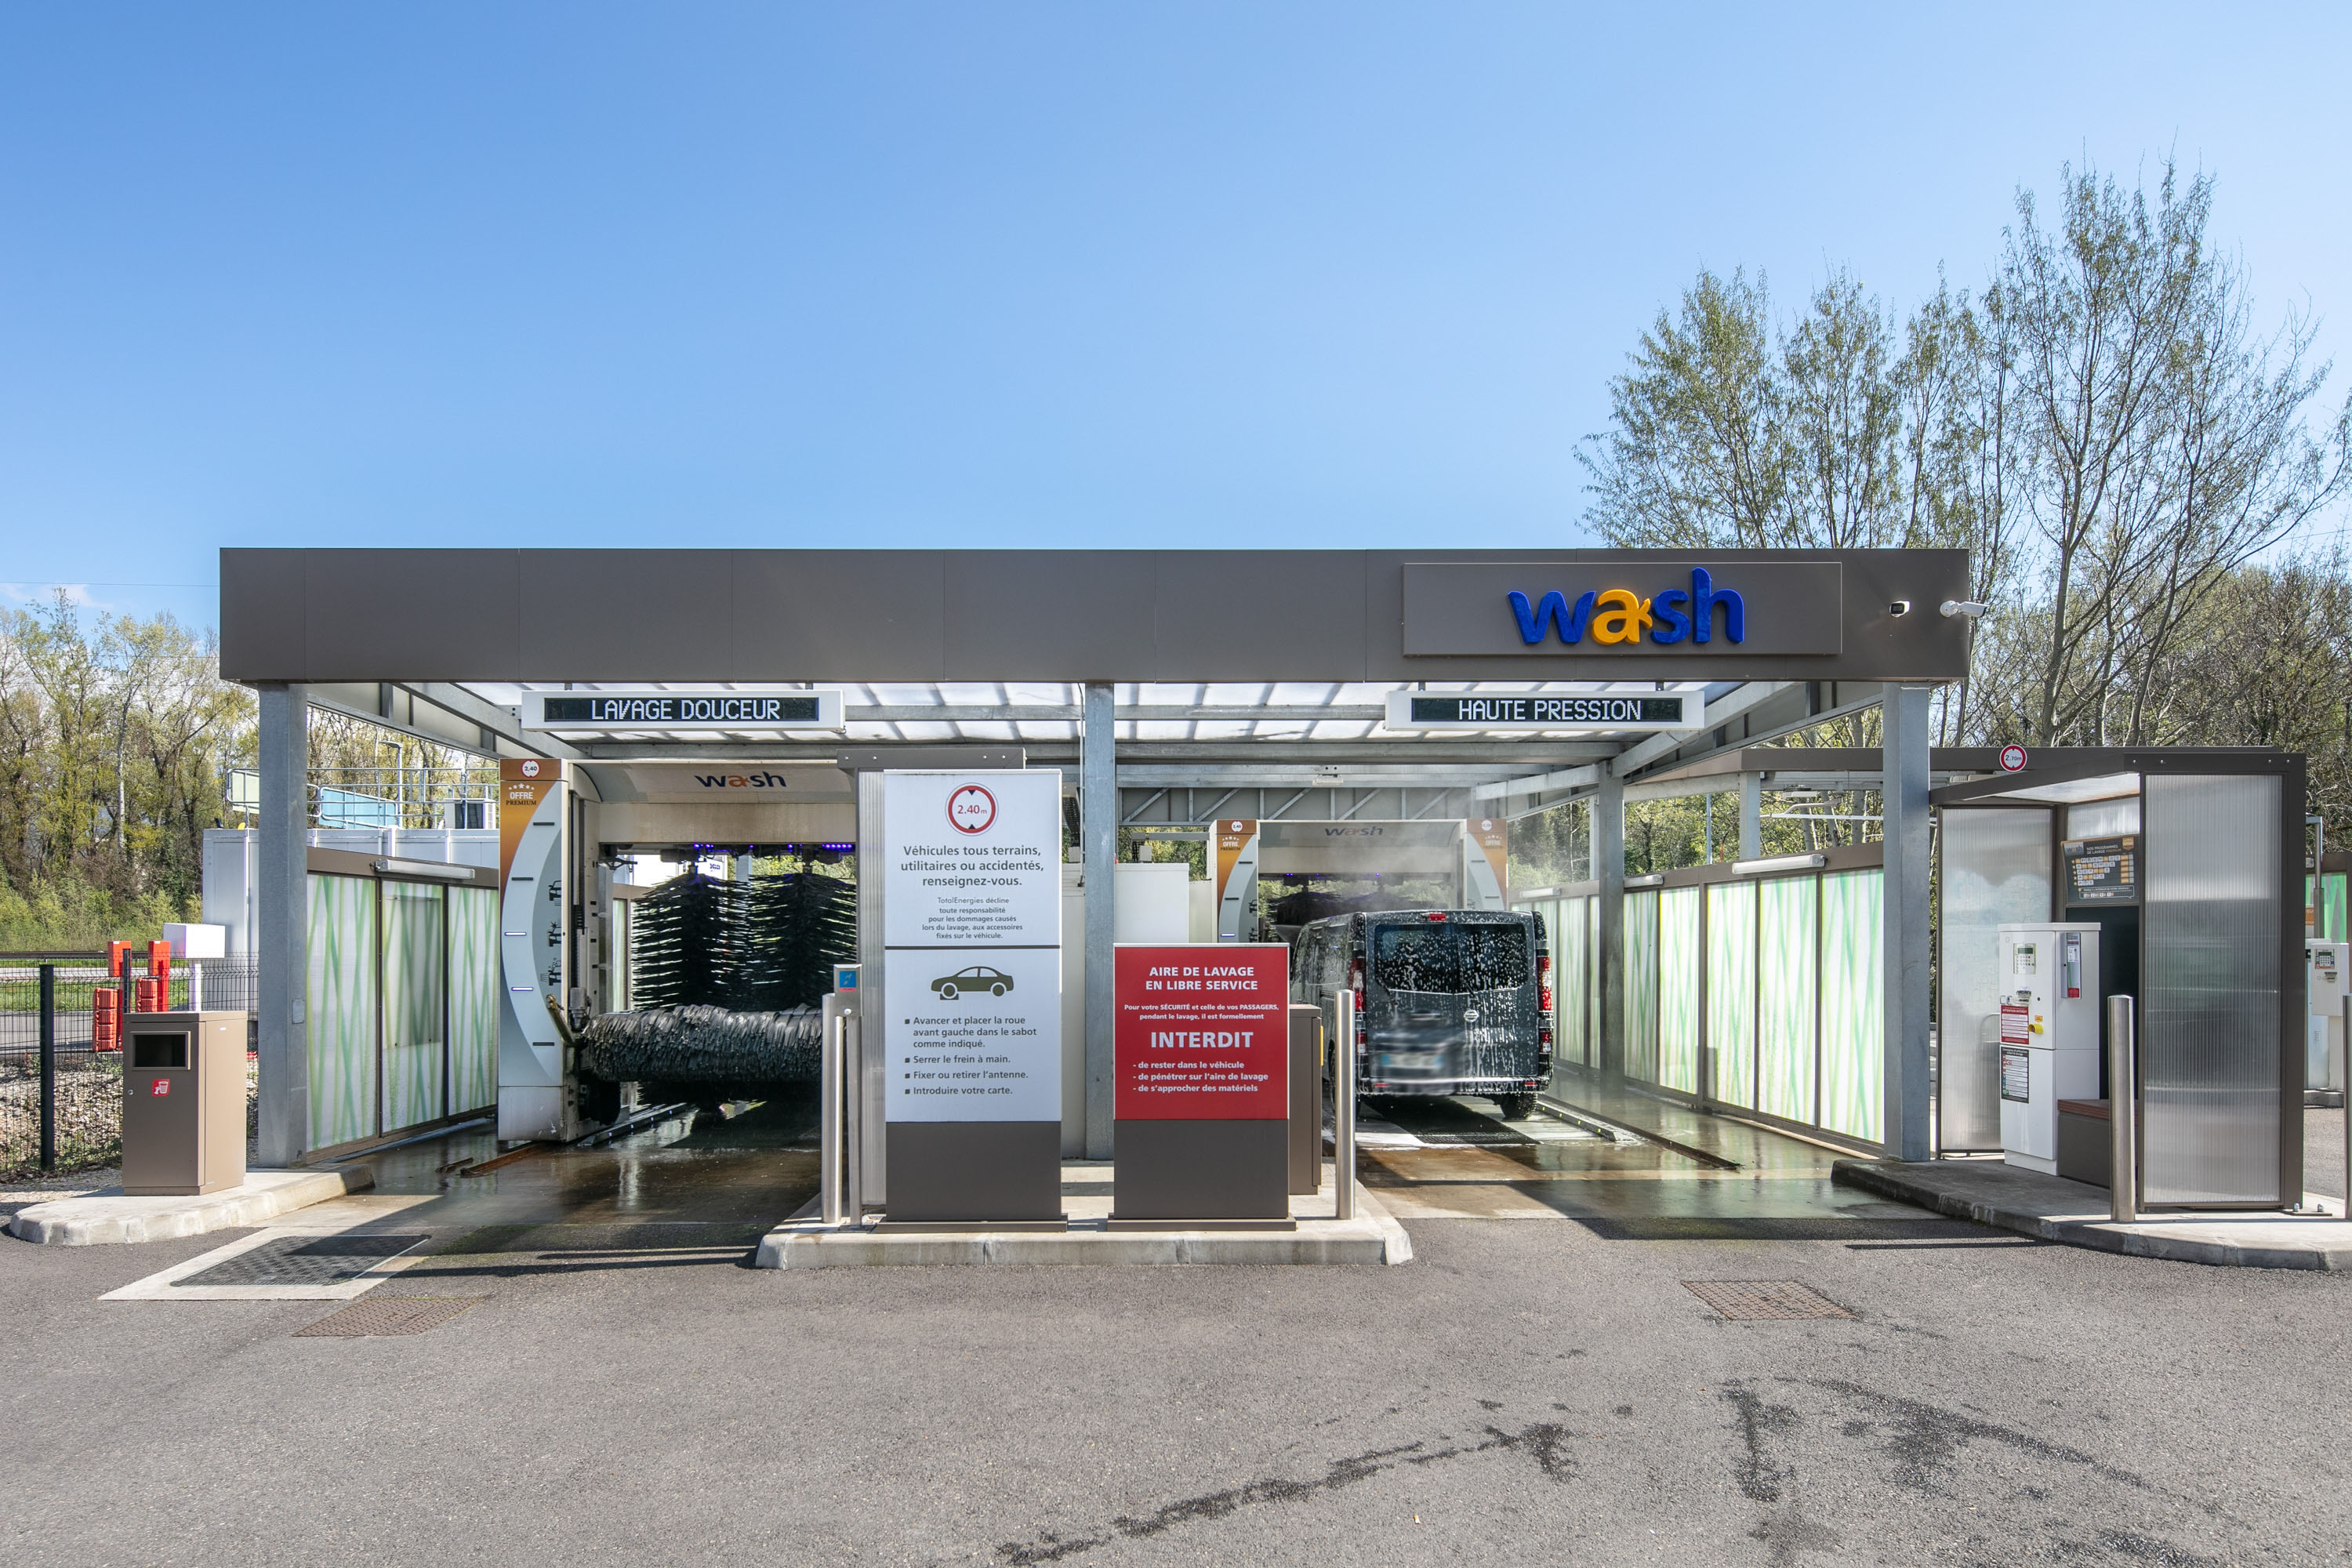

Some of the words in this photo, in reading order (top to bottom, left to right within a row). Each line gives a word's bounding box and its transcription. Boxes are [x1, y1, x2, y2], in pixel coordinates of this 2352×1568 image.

[1507, 567, 1744, 645] wash
[591, 699, 673, 720] LAVAGE
[681, 699, 780, 720] DOUCEUR
[1459, 700, 1526, 720] HAUTE
[1534, 700, 1641, 720] PRESSION
[694, 771, 787, 787] wash
[1325, 826, 1383, 836] wash
[904, 846, 959, 856] Véhicules
[993, 845, 1041, 857] terrains,
[901, 862, 956, 871] utilitaires
[979, 861, 1044, 872] accidentés,
[923, 877, 1022, 888] renseignez-vous.
[1149, 967, 1178, 976] AIRE
[1183, 967, 1200, 976] DE
[1204, 967, 1254, 976] LAVAGE
[1206, 981, 1258, 989] SERVICE
[965, 1017, 991, 1026] placer
[942, 1029, 974, 1037] gauche
[949, 1040, 985, 1049] indiqué.
[1151, 1033, 1254, 1047] INTERDIT
